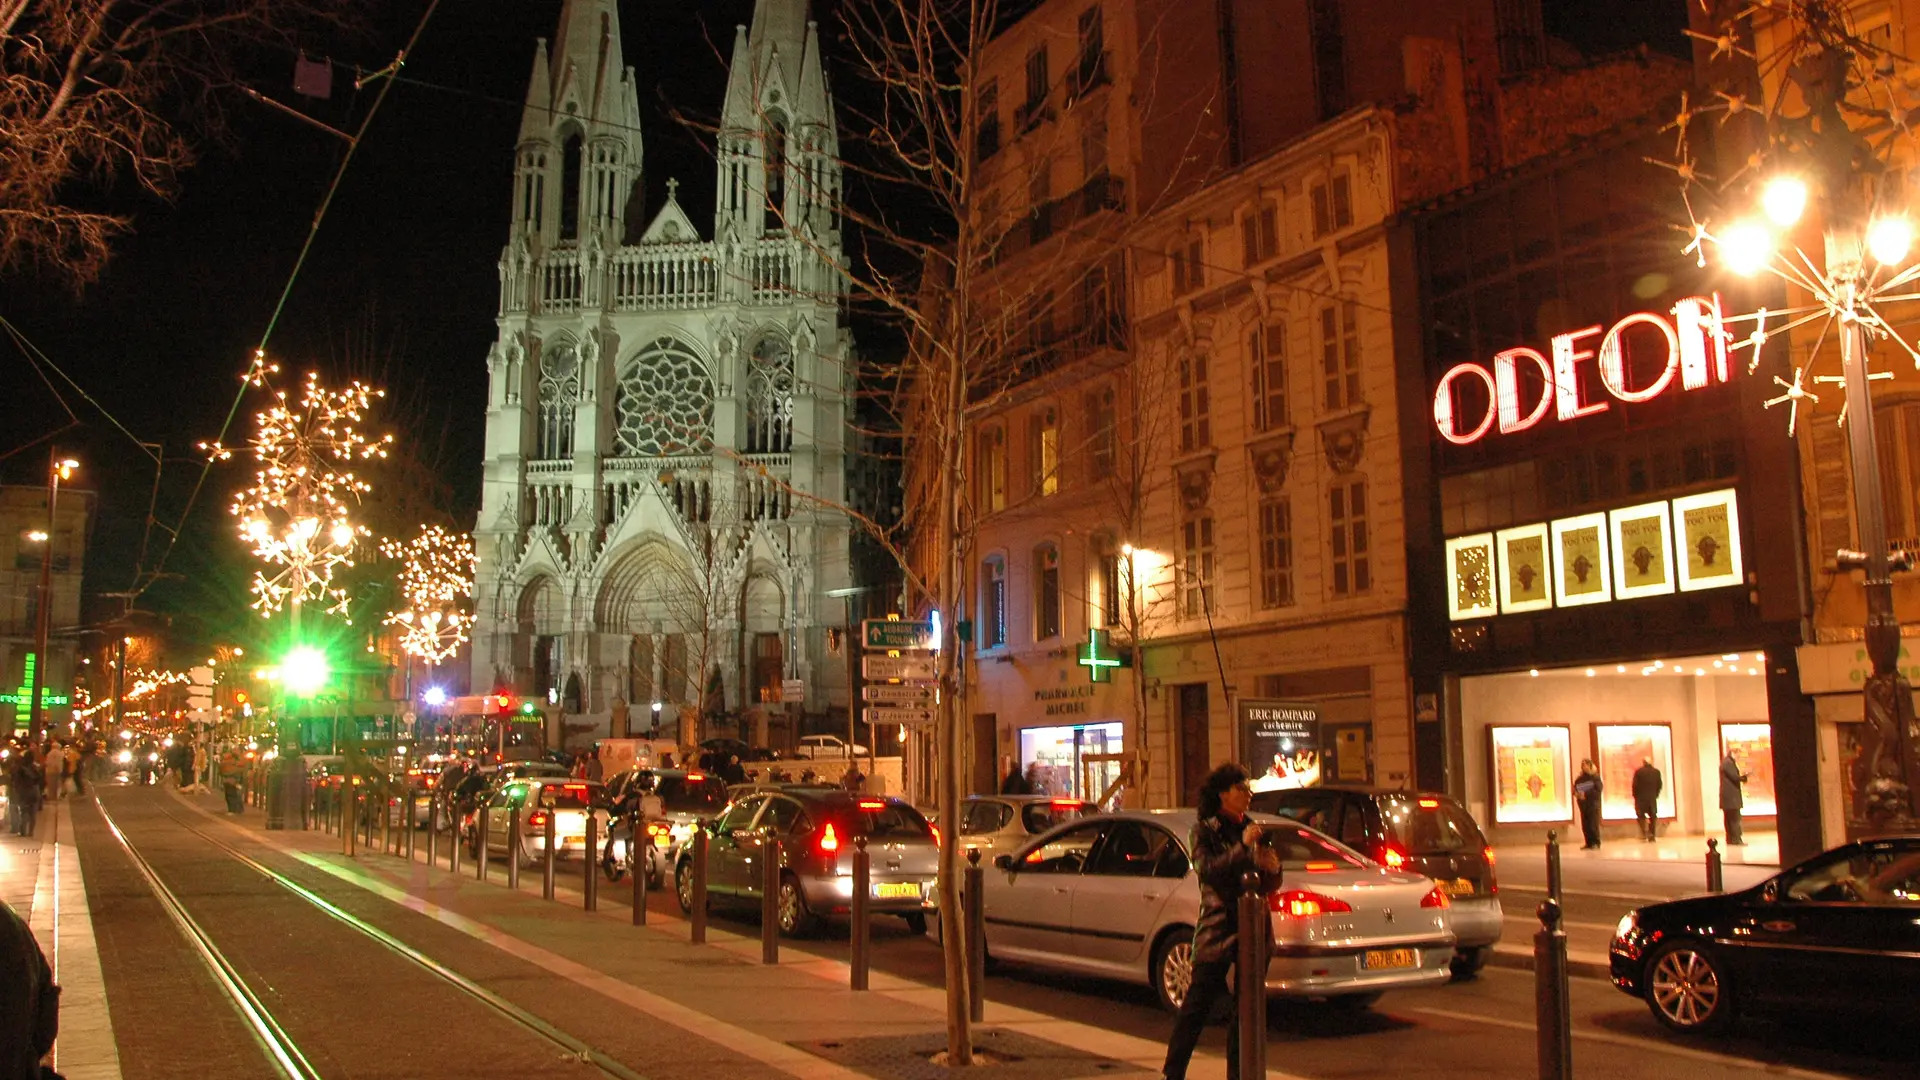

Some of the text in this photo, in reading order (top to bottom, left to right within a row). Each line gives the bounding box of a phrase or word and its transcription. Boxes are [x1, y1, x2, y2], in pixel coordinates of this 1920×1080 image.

[1433, 290, 1728, 445] ODEON
[1046, 702, 1085, 717] MICHEL
[1249, 708, 1316, 721] ERIC BOMPARD
